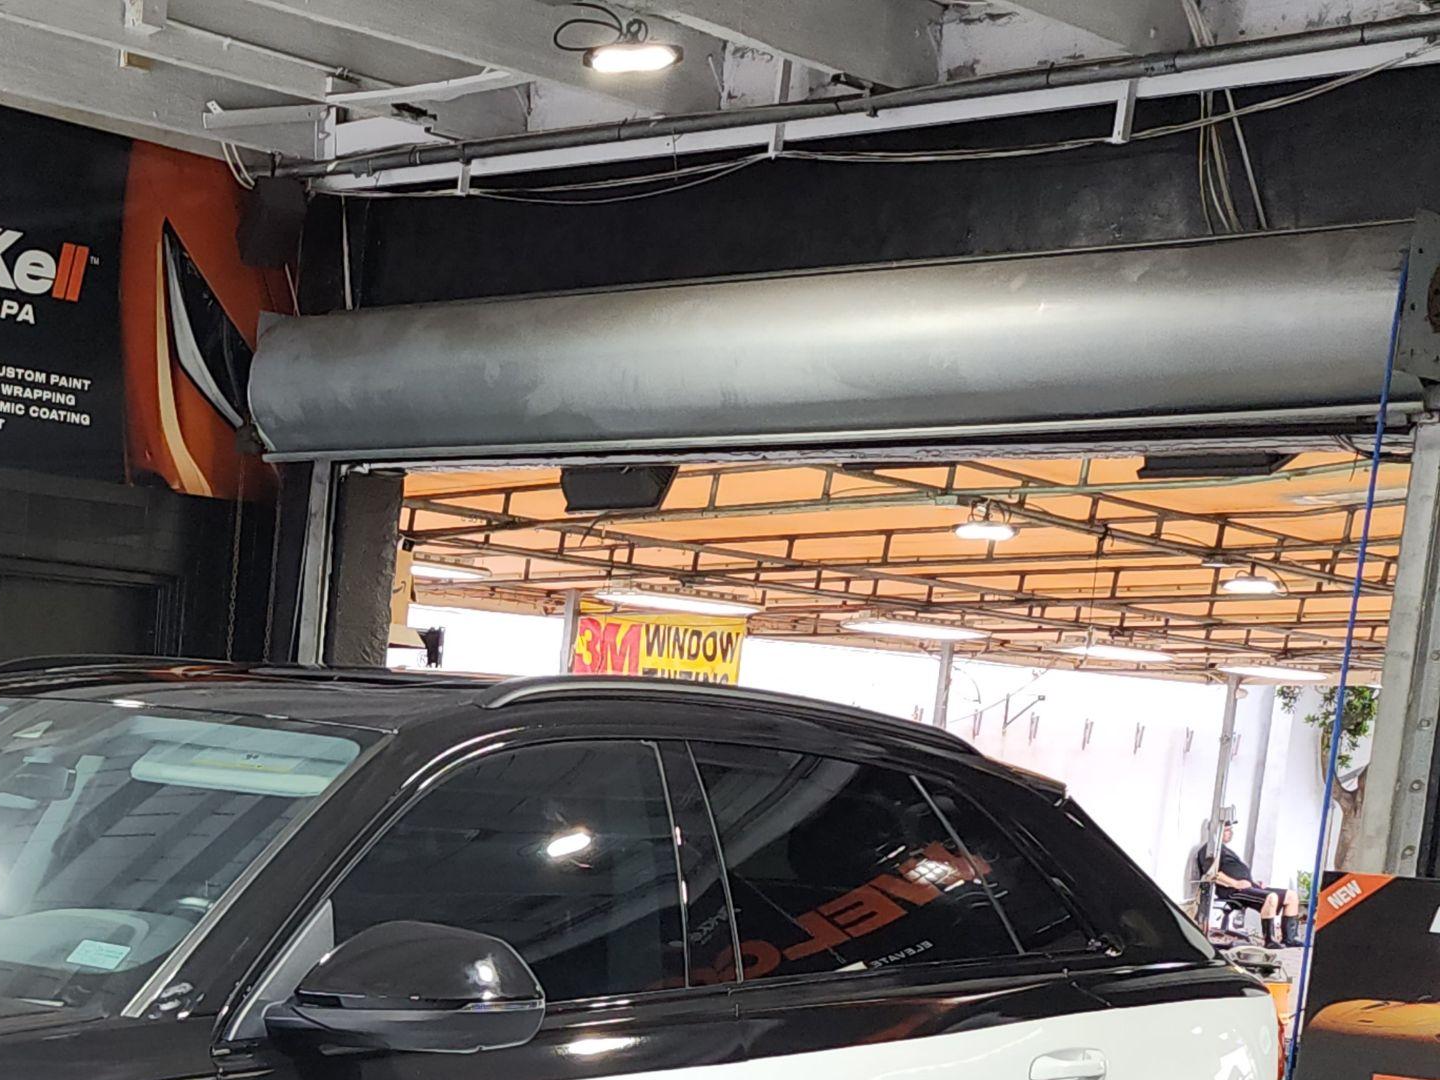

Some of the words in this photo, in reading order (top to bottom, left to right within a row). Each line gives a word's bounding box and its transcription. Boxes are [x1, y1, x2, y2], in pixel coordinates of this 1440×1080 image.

[50, 374, 91, 391] PAINT
[1, 383, 76, 406] WRAPPING
[29, 406, 90, 426] COATING
[573, 617, 643, 676] 3M
[644, 624, 741, 664] WINDOW
[1327, 880, 1362, 909] NEW
